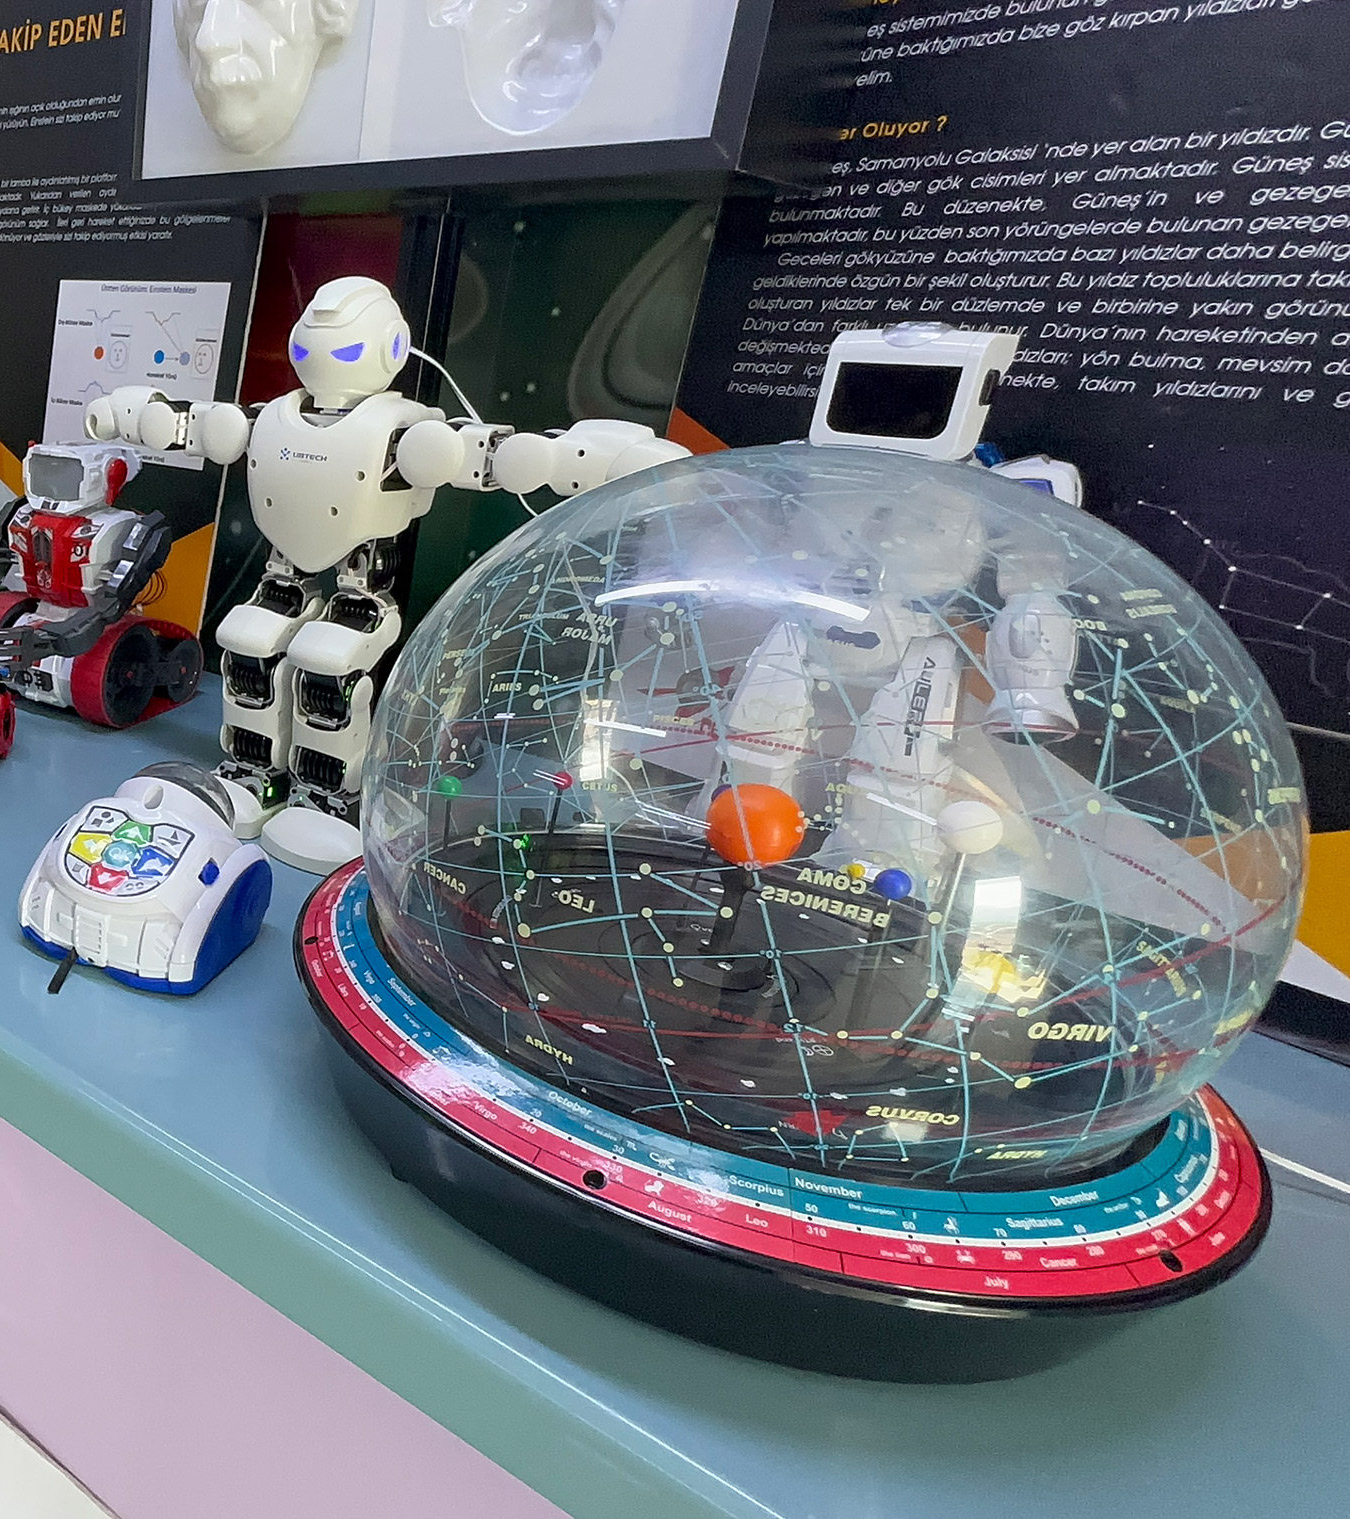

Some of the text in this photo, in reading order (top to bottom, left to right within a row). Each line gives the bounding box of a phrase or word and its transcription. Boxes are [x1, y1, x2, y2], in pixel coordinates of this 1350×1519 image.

[48, 13, 102, 48] EDEN
[110, 8, 126, 39] E
[888, 5, 1001, 34] sistemimizde
[897, 28, 1014, 57] baktığımızda
[1018, 22, 1060, 41] bize
[1064, 15, 1105, 38] göz
[1109, 7, 1179, 29] kırpan
[862, 115, 949, 139] Oluyor ?
[856, 152, 952, 173] Samanyolu
[955, 144, 1039, 165] Galaksisi
[1091, 140, 1127, 160] yer
[1130, 135, 1181, 152] alan
[1185, 132, 1218, 150] bir
[1219, 124, 1311, 150] yıldızdır.
[850, 156, 1314, 197] ve diğer gök cisimleri yer almaktadır. Güneş
[873, 227, 896, 241] bu
[899, 225, 963, 243] yüzden
[967, 225, 999, 238] son
[1003, 219, 1142, 241] yörüngelerde
[1146, 217, 1243, 234] bulunan
[777, 243, 1274, 268] Geceleri gökyüzüne baktığımızda bazı yıldızlar daha
[753, 274, 847, 290] geldiklerinde
[851, 274, 900, 291] özgün
[903, 273, 926, 288] bir
[928, 273, 967, 291] şekil
[1056, 273, 1083, 289] Bu
[1086, 272, 1137, 292] yıldız
[1141, 271, 1301, 291] topluluklarına
[1156, 324, 1319, 346] hareketinden
[1080, 351, 1312, 374] yön bulma, mevsim
[1078, 375, 1314, 403] takım yıldızlarını ve
[387, 977, 417, 1007] September
[473, 1102, 498, 1121] Virgo
[530, 1108, 542, 1118] 20
[548, 1091, 593, 1117] October
[518, 1121, 537, 1135] 340
[613, 1144, 625, 1155] 30
[728, 1175, 785, 1197] Scorpius
[794, 1177, 863, 1199] November
[805, 1203, 819, 1213] 50
[1049, 1191, 1100, 1207] December
[648, 1200, 692, 1223] August
[745, 1213, 769, 1228] Leo
[806, 1225, 827, 1238] 310
[902, 1221, 916, 1231] 60
[1005, 1217, 1064, 1231] Sagittarius
[906, 1242, 926, 1255] 300
[1039, 1257, 1078, 1269] Cancer
[984, 1276, 1009, 1290] July
